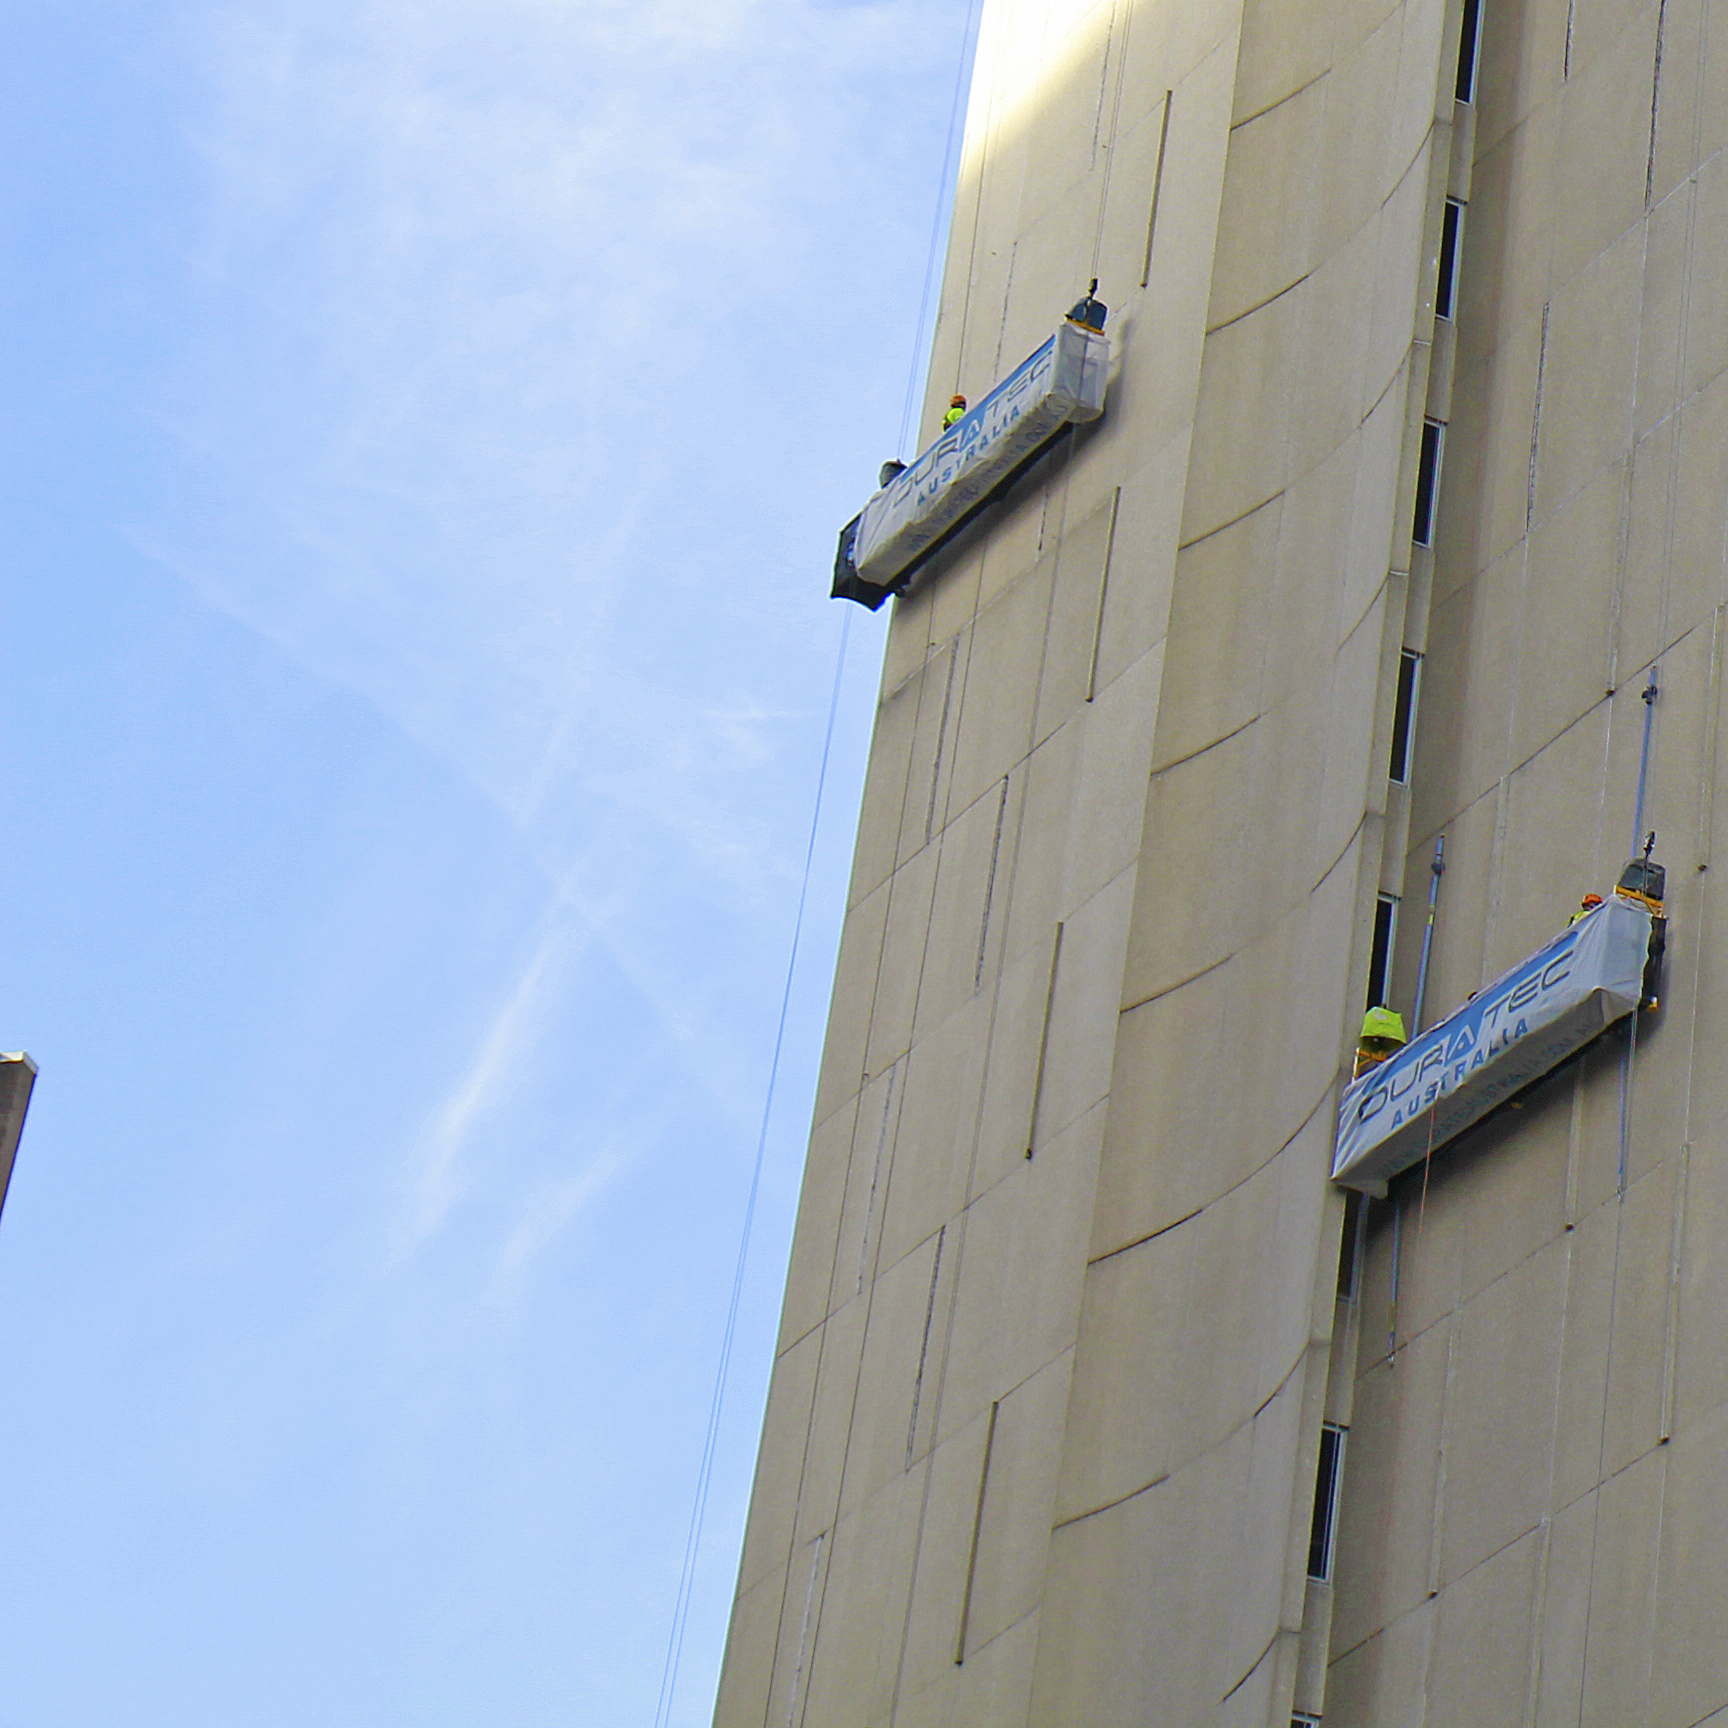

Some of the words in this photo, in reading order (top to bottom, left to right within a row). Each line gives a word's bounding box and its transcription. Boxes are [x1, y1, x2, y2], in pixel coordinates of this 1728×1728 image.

[917, 403, 1022, 507] AUSTRALIA
[1357, 949, 1575, 1122] DURATEC
[1391, 1017, 1530, 1131] AUSTRALIA
